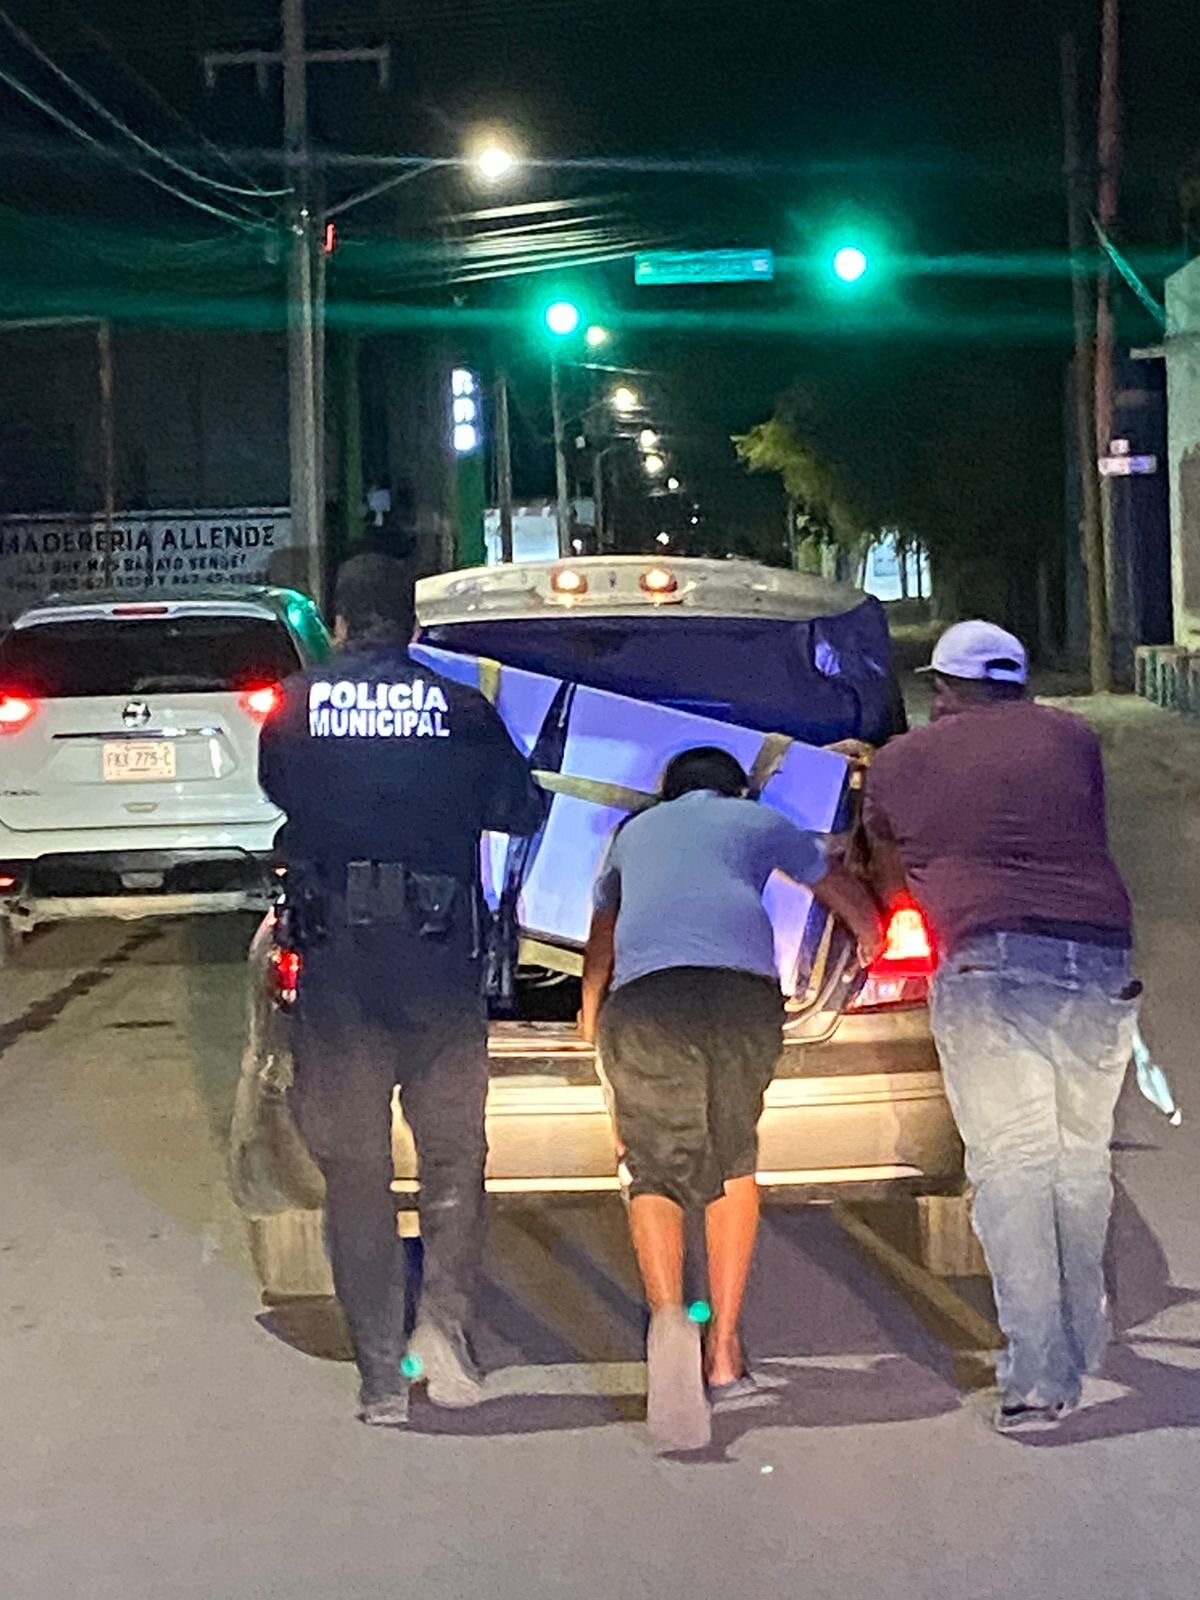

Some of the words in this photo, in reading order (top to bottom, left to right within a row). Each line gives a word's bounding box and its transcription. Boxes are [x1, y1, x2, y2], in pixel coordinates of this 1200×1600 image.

[162, 525, 275, 551] ALLENDE
[309, 679, 449, 712] POLICÍA
[309, 708, 451, 737] MUNICIPAL
